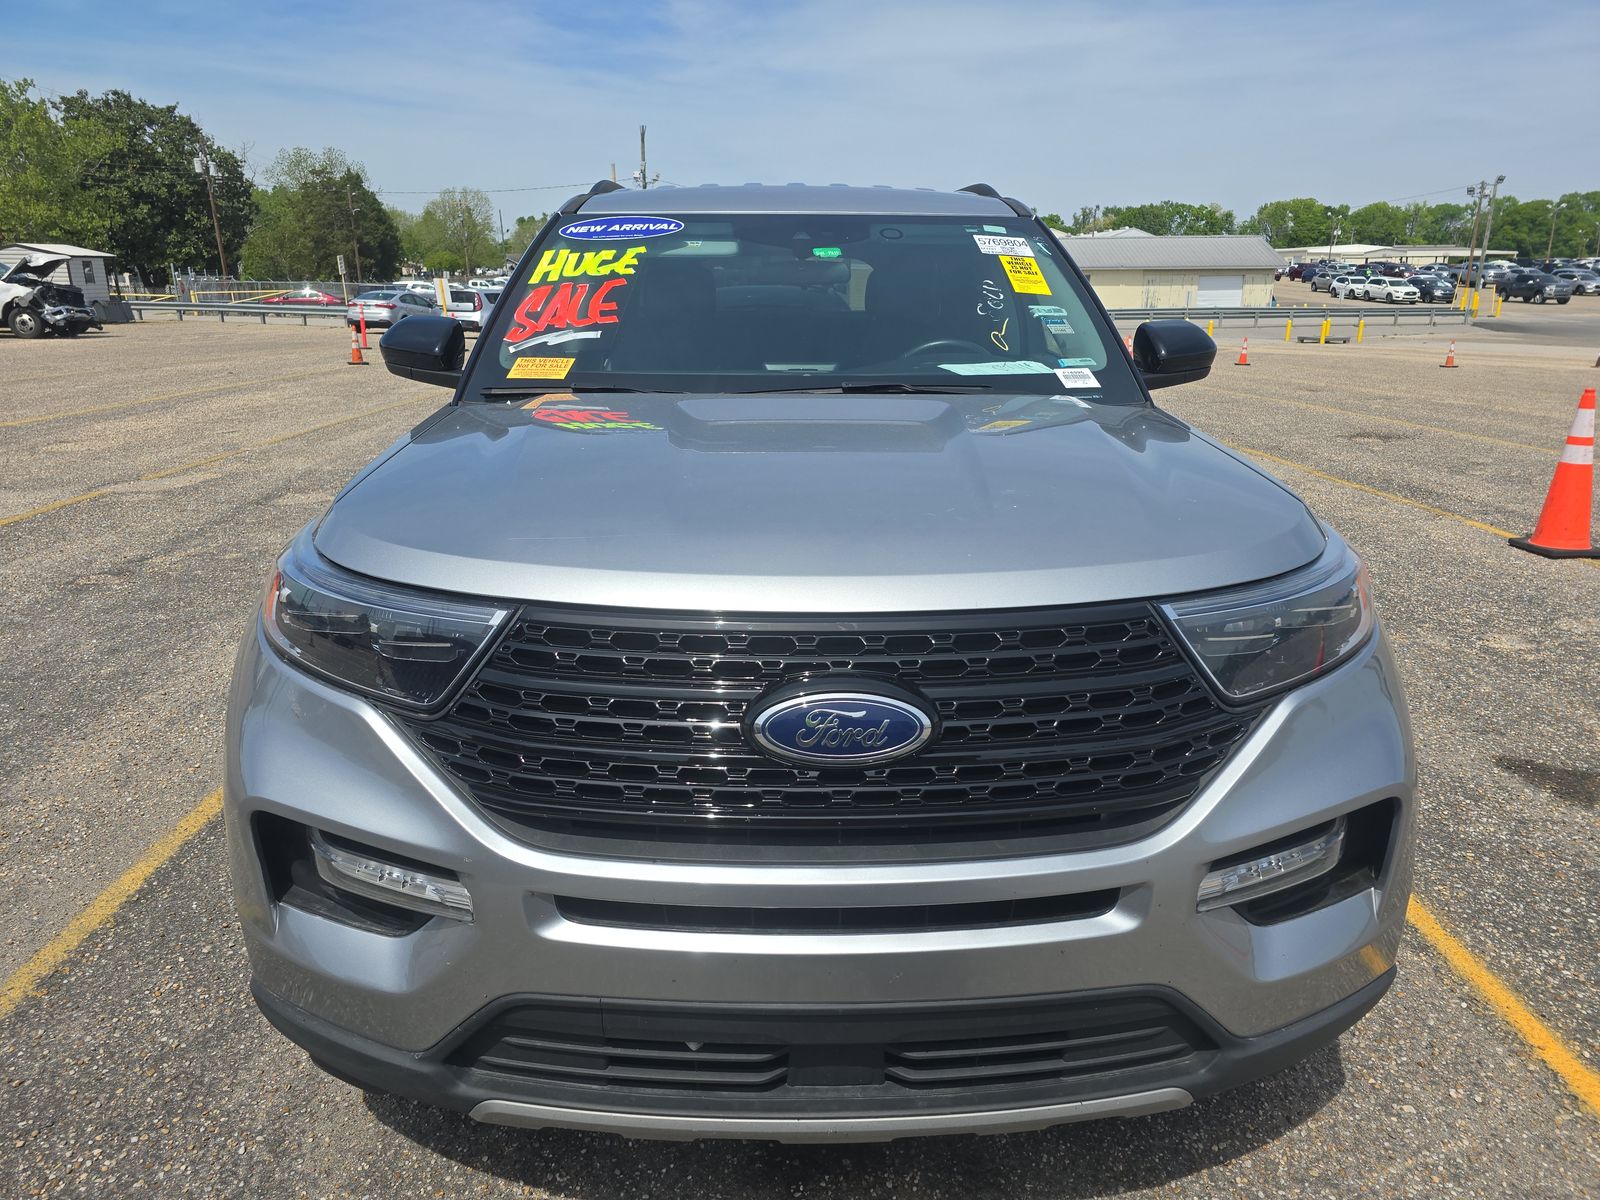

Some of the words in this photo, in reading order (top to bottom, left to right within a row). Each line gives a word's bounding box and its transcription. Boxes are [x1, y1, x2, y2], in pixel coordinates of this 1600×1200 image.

[565, 225, 607, 234] NEW
[606, 223, 679, 232] ARRIVAL
[977, 237, 1028, 247] 5769804
[528, 246, 647, 284] HUGE
[503, 278, 627, 342] SALE
[795, 708, 891, 748] Ford
